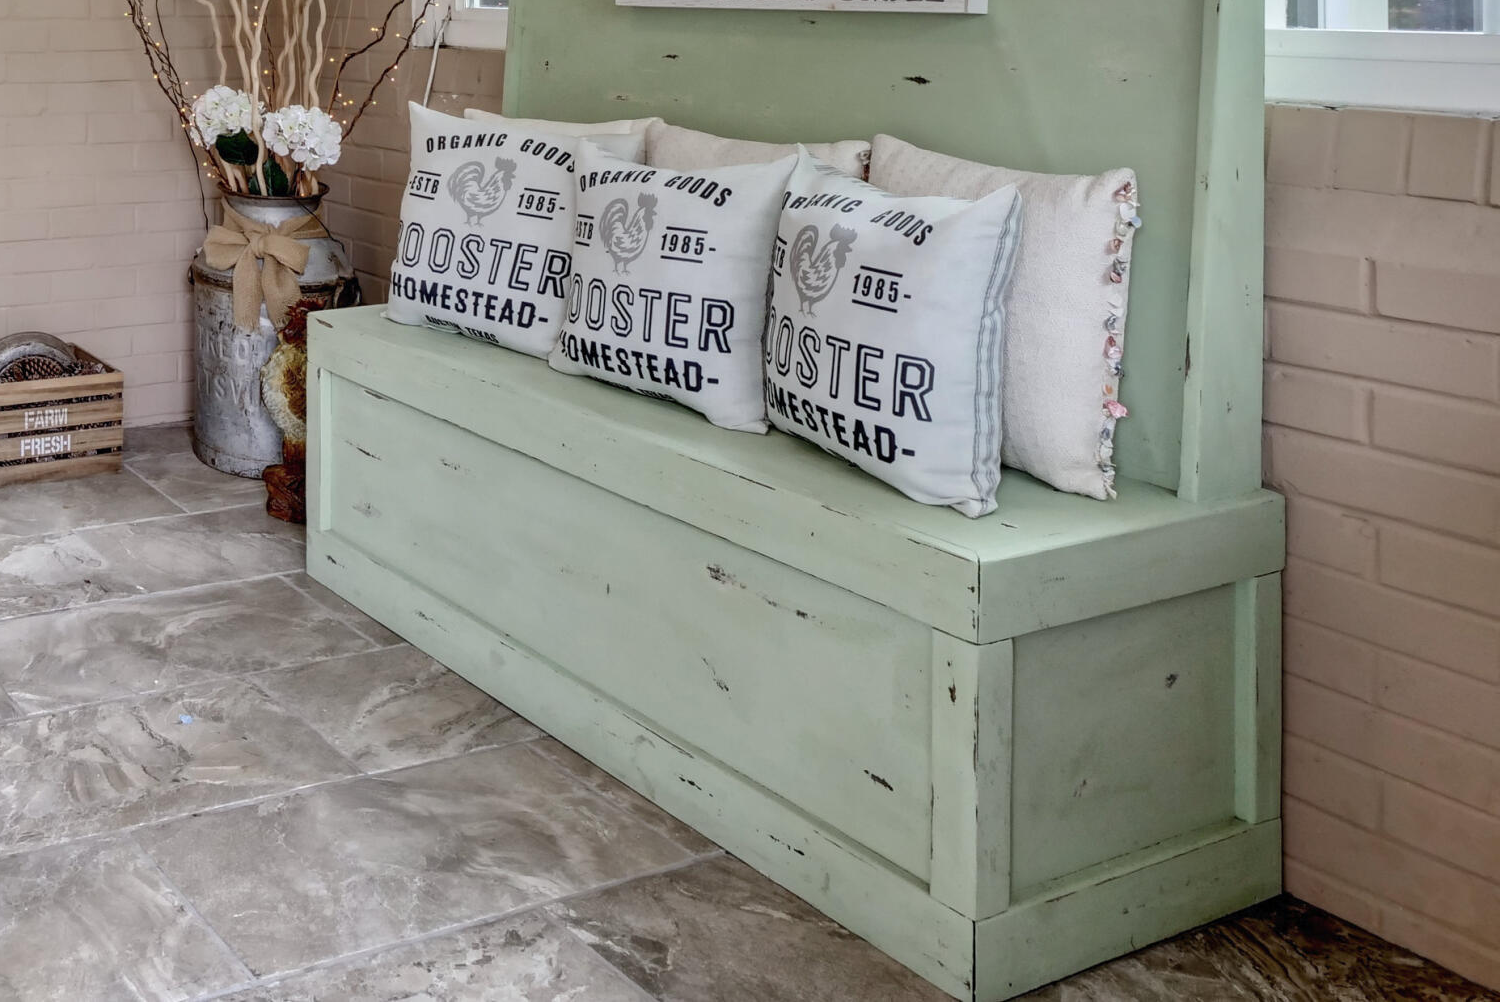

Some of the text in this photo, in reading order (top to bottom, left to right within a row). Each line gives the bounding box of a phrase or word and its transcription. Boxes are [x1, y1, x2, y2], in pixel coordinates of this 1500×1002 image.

[426, 132, 576, 173] ORGANIC GOODS
[580, 170, 733, 207] ORGANIC GOODS
[869, 209, 934, 246] GOODS
[397, 220, 573, 299] OOSTER
[567, 273, 735, 354] OOSTER
[766, 305, 935, 423] OOSTER
[24, 407, 68, 431] FARM
[766, 377, 916, 465] OMESTEAD-
[20, 434, 72, 458] FRESH
